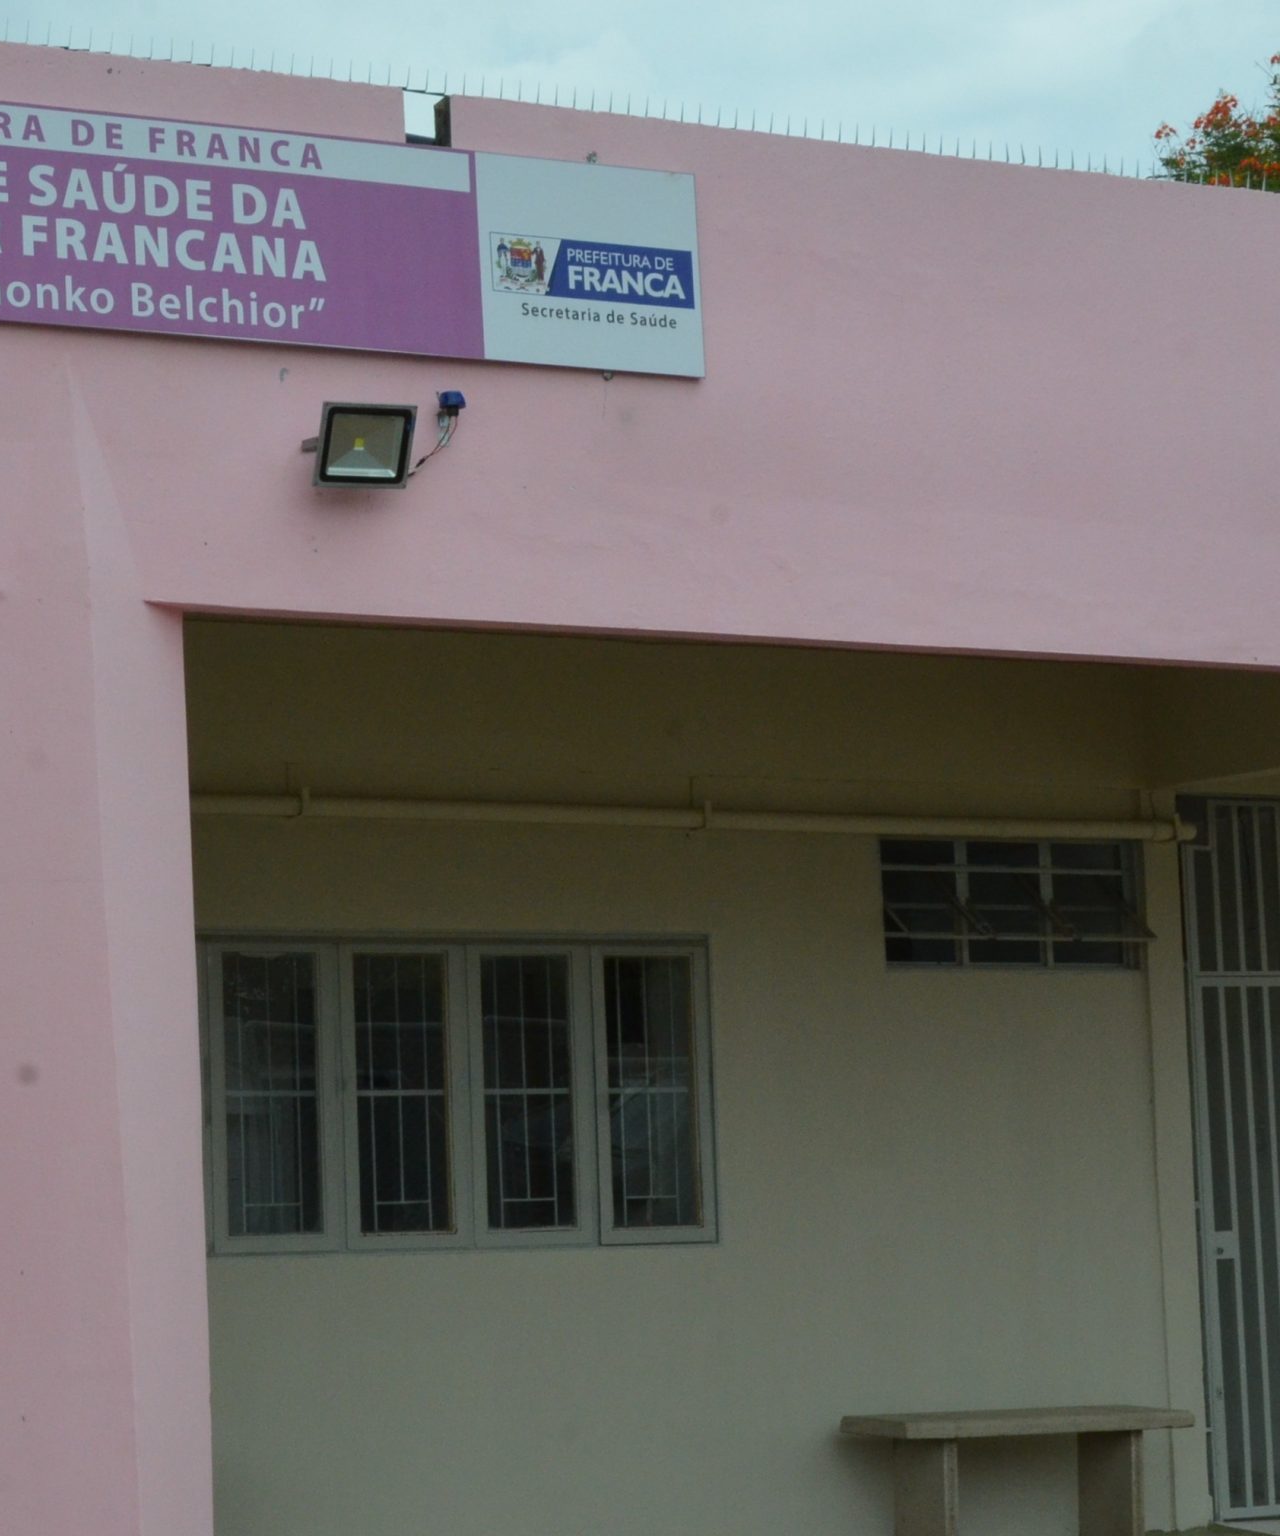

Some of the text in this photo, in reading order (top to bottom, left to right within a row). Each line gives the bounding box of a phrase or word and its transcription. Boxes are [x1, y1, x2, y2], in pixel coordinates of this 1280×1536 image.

[70, 119, 125, 151] DE
[148, 127, 324, 170] FRANCA
[27, 163, 213, 222] SAÚDE
[232, 183, 307, 230] DA
[21, 216, 327, 282] FRANCANA
[566, 248, 674, 272] PREFEITURA DE
[131, 282, 326, 330] Belchior”
[567, 265, 686, 300] FRANCA
[521, 302, 678, 330] Secretaria de Saúde
